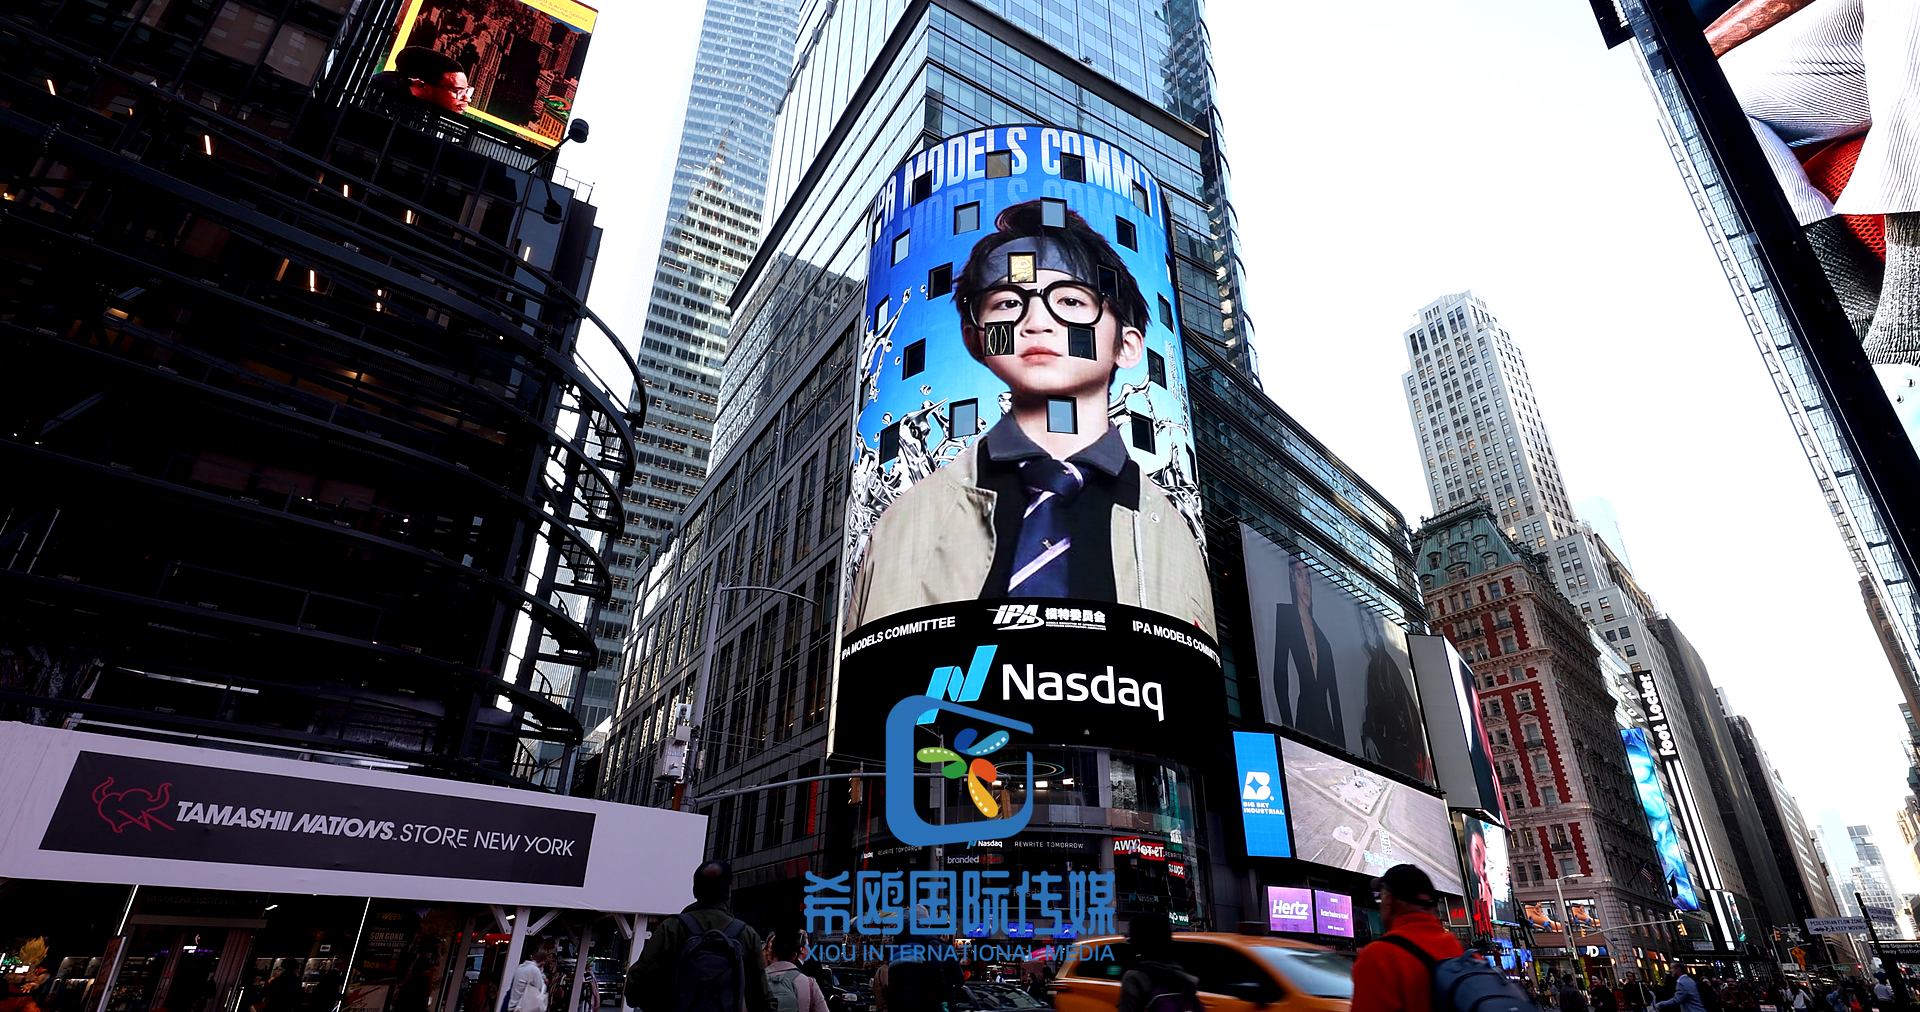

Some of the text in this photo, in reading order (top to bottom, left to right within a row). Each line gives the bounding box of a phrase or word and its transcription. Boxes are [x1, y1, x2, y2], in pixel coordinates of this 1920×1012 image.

[903, 127, 1028, 212] MODELS
[993, 604, 1039, 625] IPA
[851, 632, 884, 655] MODELS
[885, 616, 956, 641] COMMITTEE
[1132, 620, 1153, 635] IPA
[1153, 624, 1192, 647] MODELS
[1002, 663, 1165, 722] Nasdaq
[1639, 673, 1677, 756] Foot Locker
[1243, 808, 1285, 816] INDUSTRIAL
[176, 801, 294, 832] TAMASHII
[400, 823, 469, 849] STORE
[474, 830, 521, 851] NEW
[524, 835, 575, 857] YORK
[978, 840, 1003, 849] Nasdaq
[1047, 841, 1084, 849] TOMORROW
[947, 855, 980, 864] branded
[1273, 900, 1309, 916] Hertz
